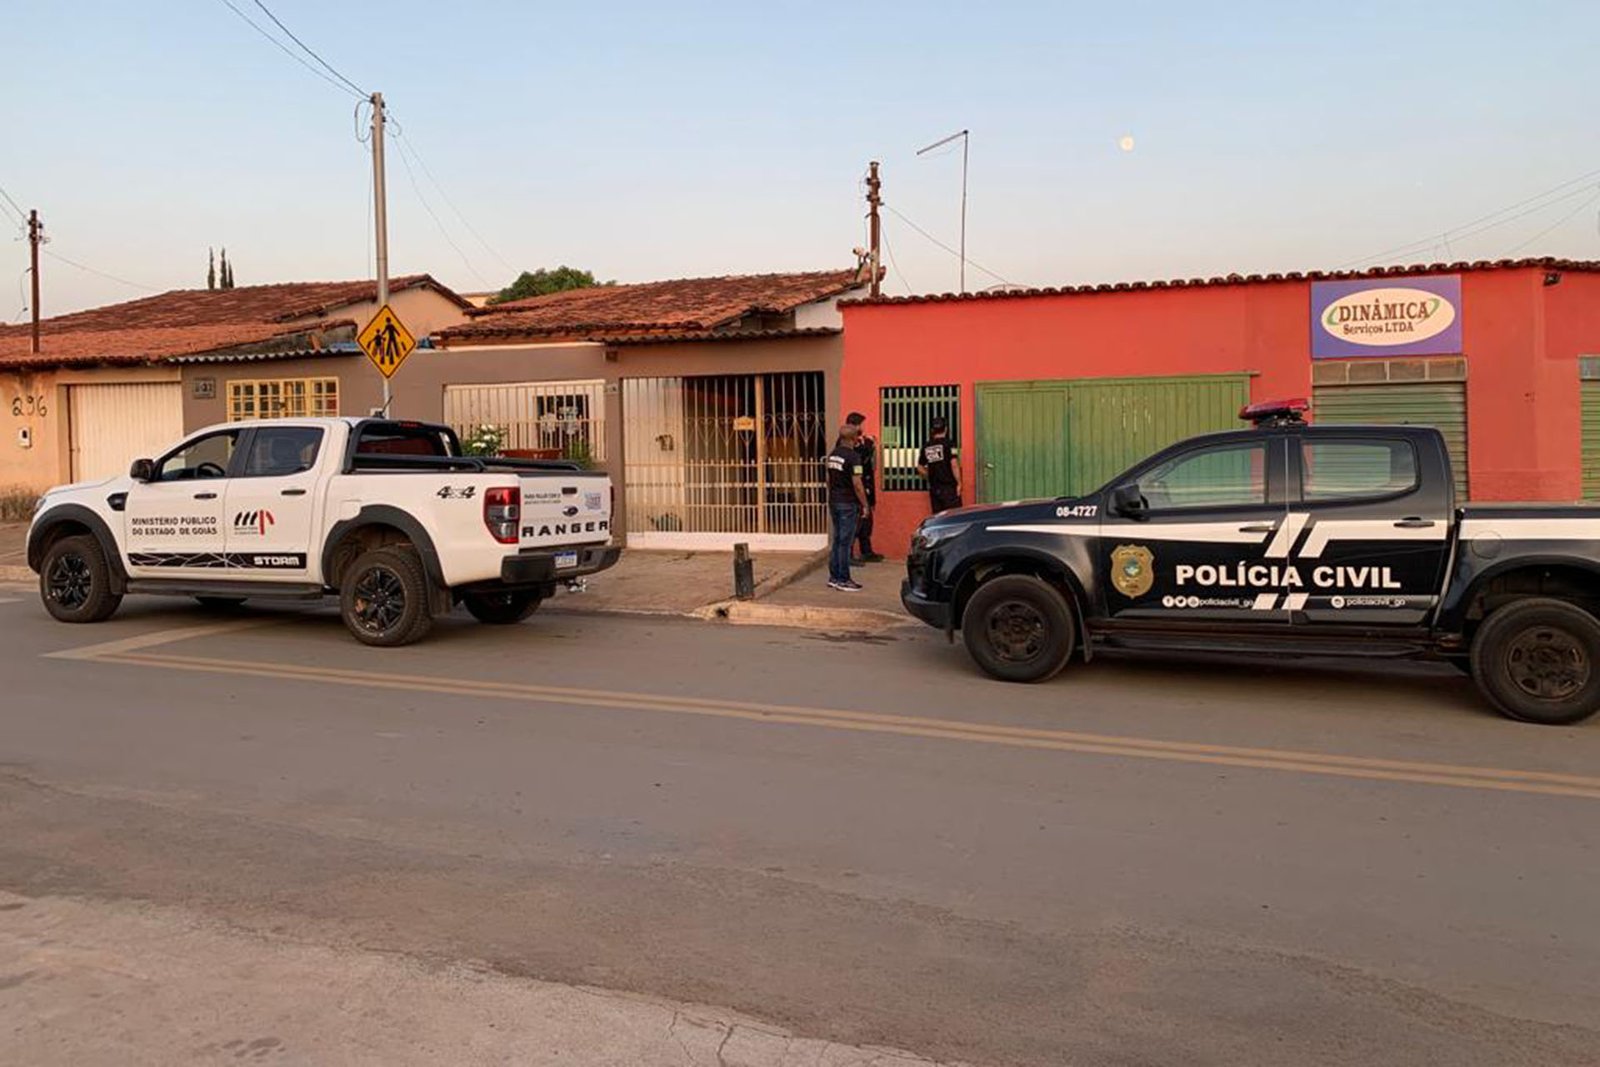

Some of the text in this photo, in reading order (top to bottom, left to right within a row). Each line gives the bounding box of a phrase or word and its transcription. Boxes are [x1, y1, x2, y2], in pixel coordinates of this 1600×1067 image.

[1338, 298, 1430, 323] DINÂMICA
[1343, 321, 1414, 336] Serviços LTDA
[12, 395, 48, 418] 296
[1056, 505, 1098, 517] 08-4727
[132, 527, 144, 536] DO
[145, 527, 176, 536] ESTADO
[179, 527, 190, 536] DE
[522, 520, 608, 537] RANGER
[253, 556, 300, 566] STORM
[1175, 560, 1401, 589] POLÍCIA CIVIL
